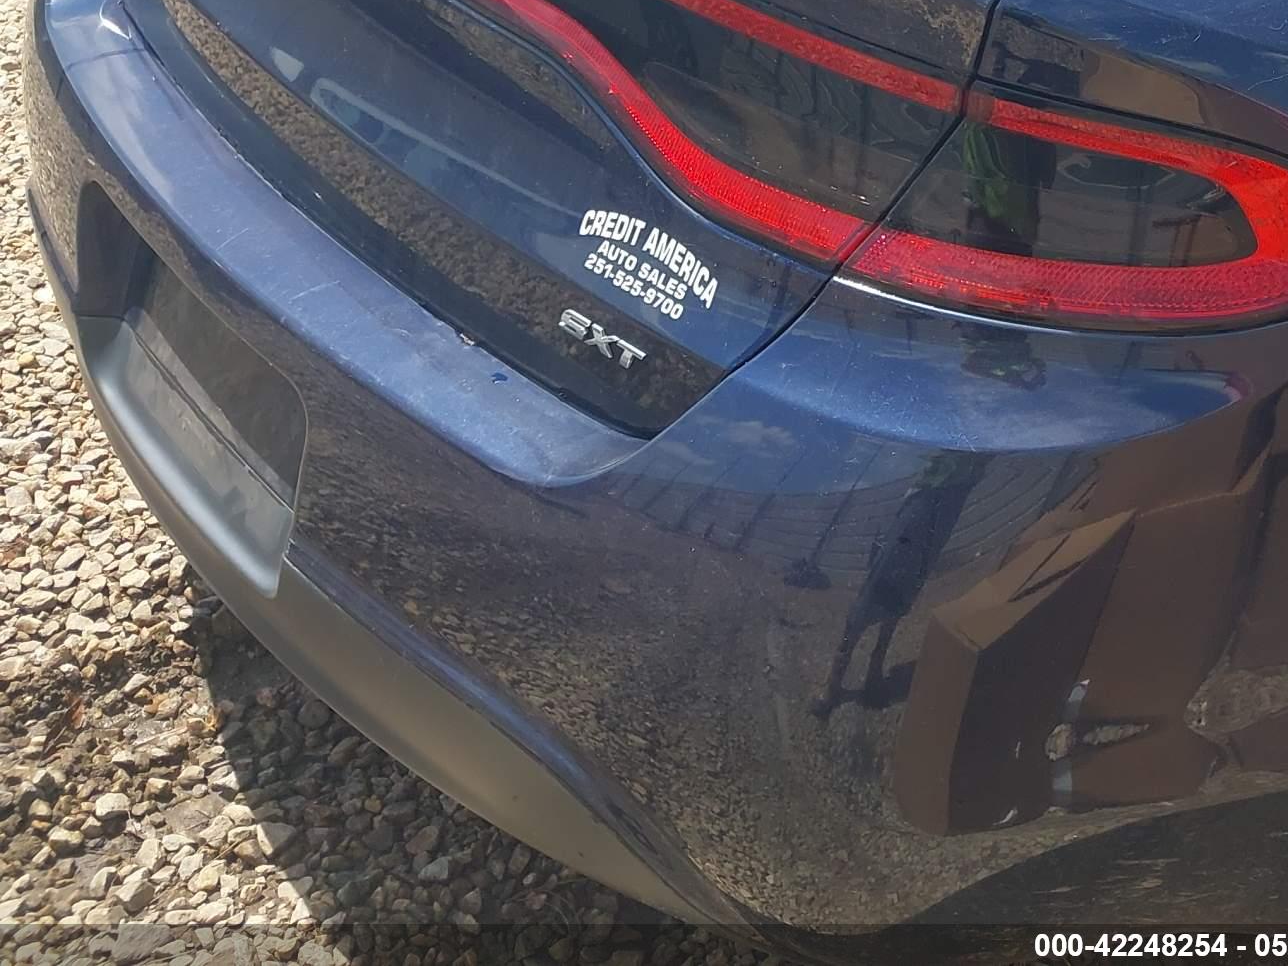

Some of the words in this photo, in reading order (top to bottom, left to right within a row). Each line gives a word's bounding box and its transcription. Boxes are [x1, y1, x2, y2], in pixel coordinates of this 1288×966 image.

[578, 209, 647, 246] CREDIT
[641, 227, 719, 310] AMERICA
[584, 252, 684, 320] 251-525-9700
[597, 240, 638, 271] AUTO
[637, 262, 688, 300] SALES
[557, 308, 647, 370] SXT
